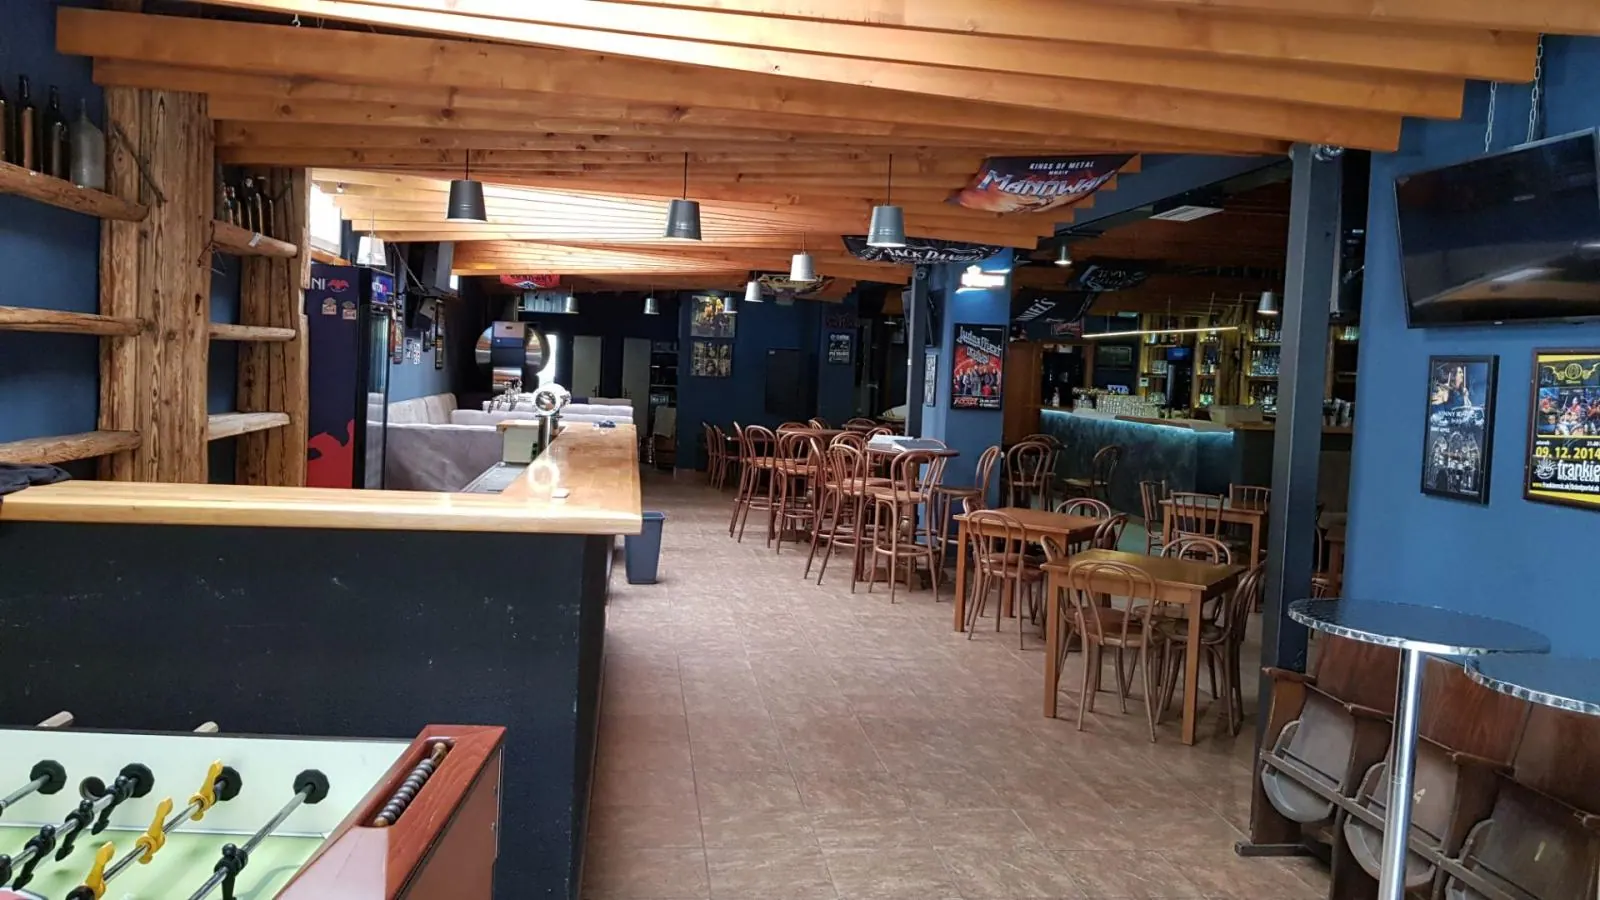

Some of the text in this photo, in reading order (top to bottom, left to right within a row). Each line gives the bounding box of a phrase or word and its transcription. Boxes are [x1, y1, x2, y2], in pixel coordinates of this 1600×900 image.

[1068, 161, 1095, 169] METAL
[1535, 446, 1552, 458] 09.
[1555, 447, 1572, 458] 12.
